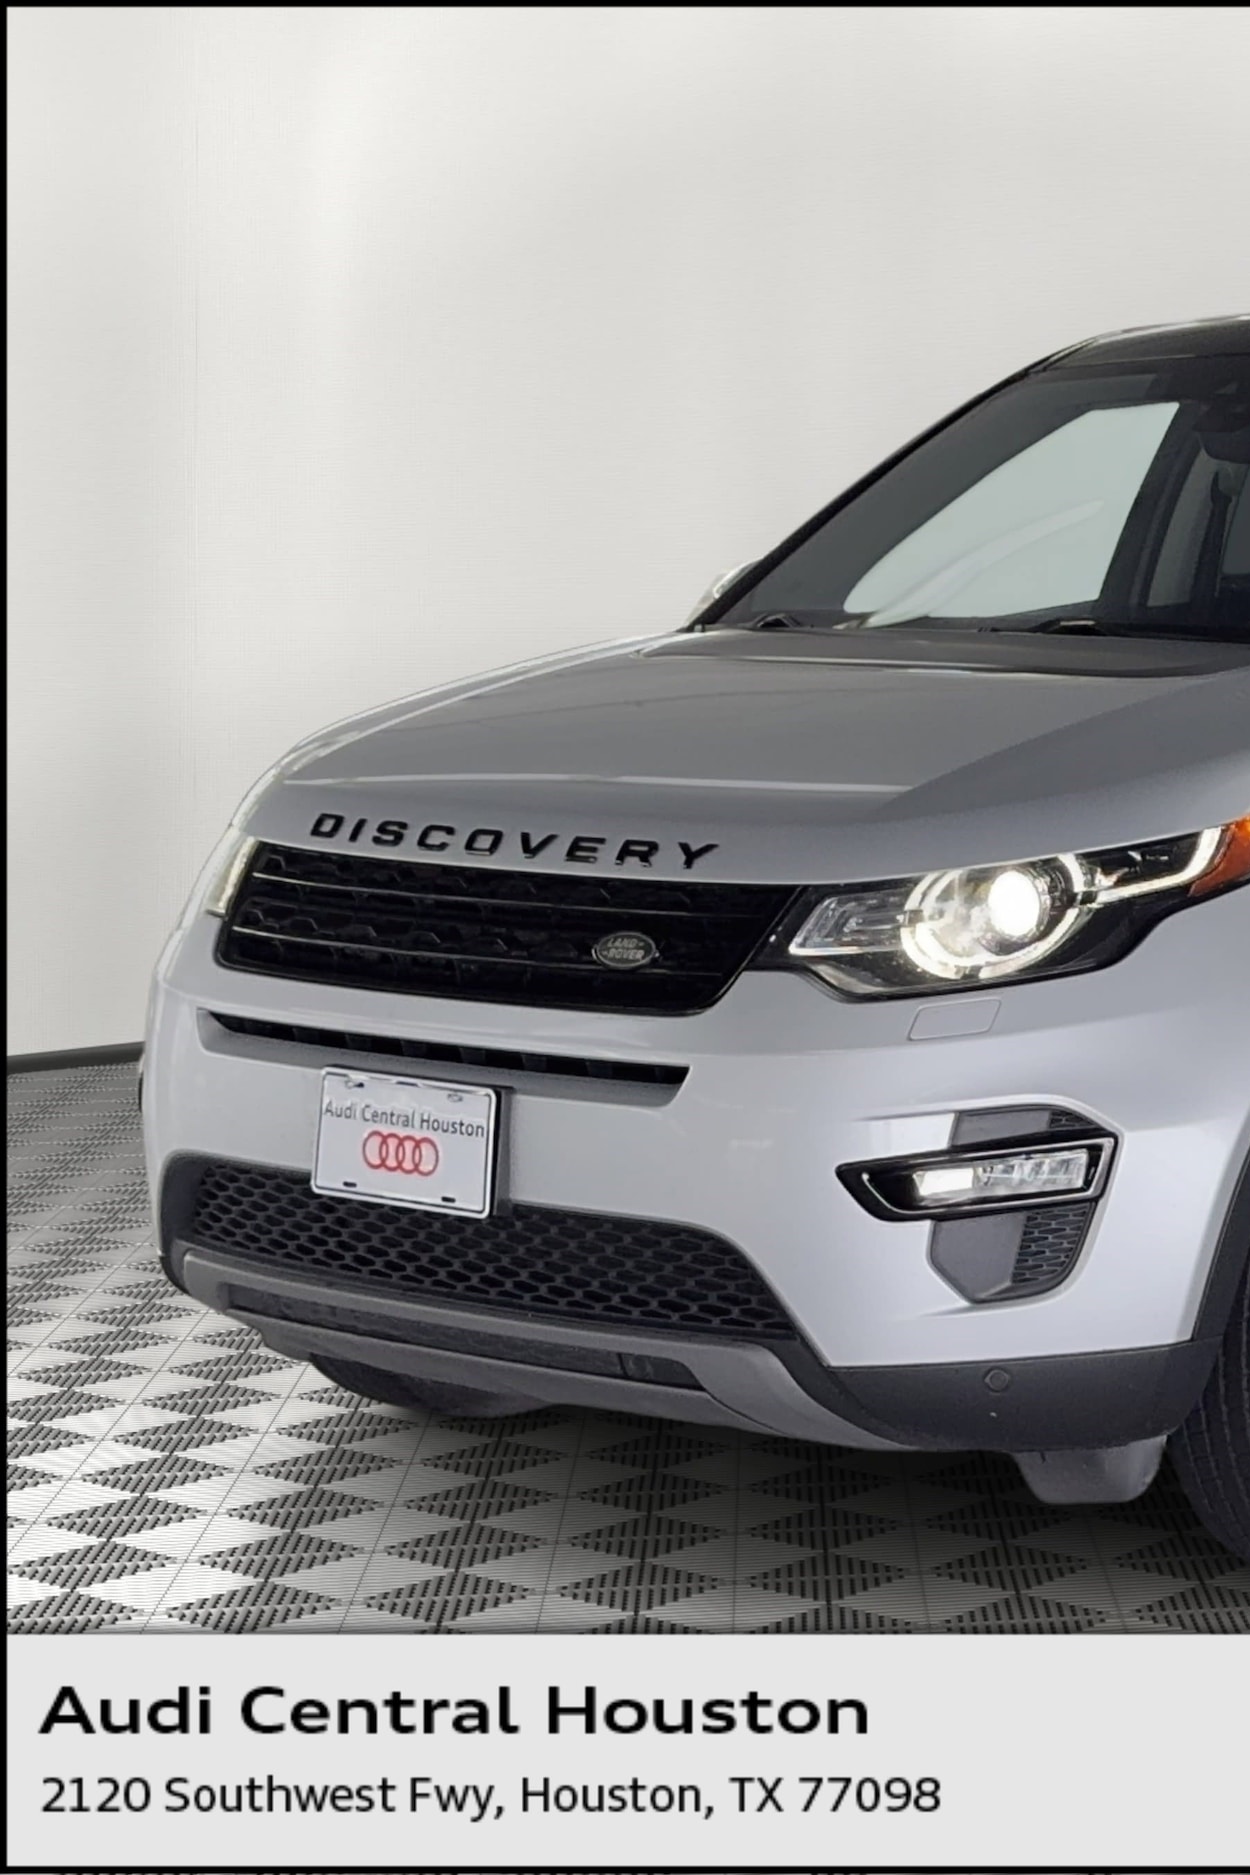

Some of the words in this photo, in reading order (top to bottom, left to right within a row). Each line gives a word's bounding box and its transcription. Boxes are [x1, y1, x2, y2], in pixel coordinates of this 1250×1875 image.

[310, 812, 719, 870] DISCOVERY
[324, 1100, 358, 1121] Audi
[361, 1104, 416, 1129] Central
[420, 1112, 485, 1138] Houston
